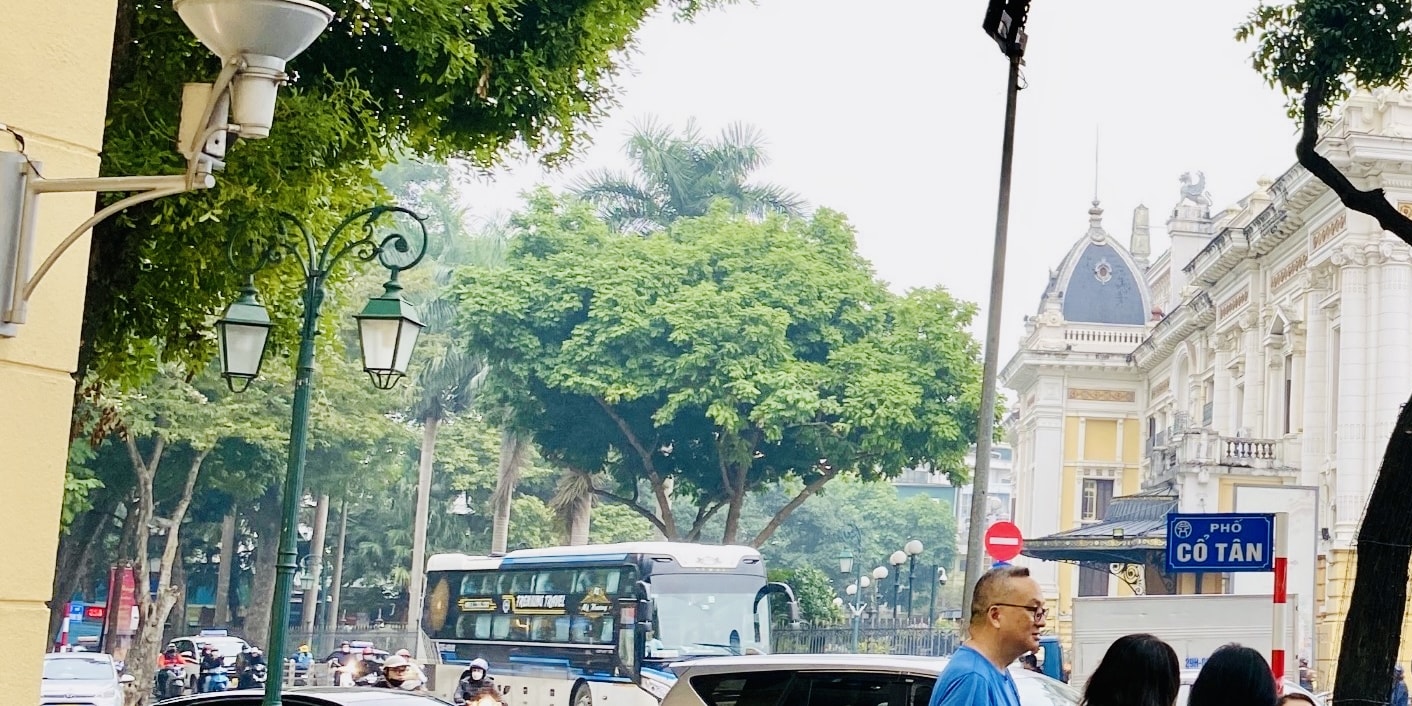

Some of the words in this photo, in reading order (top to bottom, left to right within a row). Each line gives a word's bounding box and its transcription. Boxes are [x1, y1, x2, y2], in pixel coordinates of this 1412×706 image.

[1209, 518, 1243, 533] PHỐ
[1176, 534, 1210, 563] CỔ
[1215, 538, 1263, 562] TÂN
